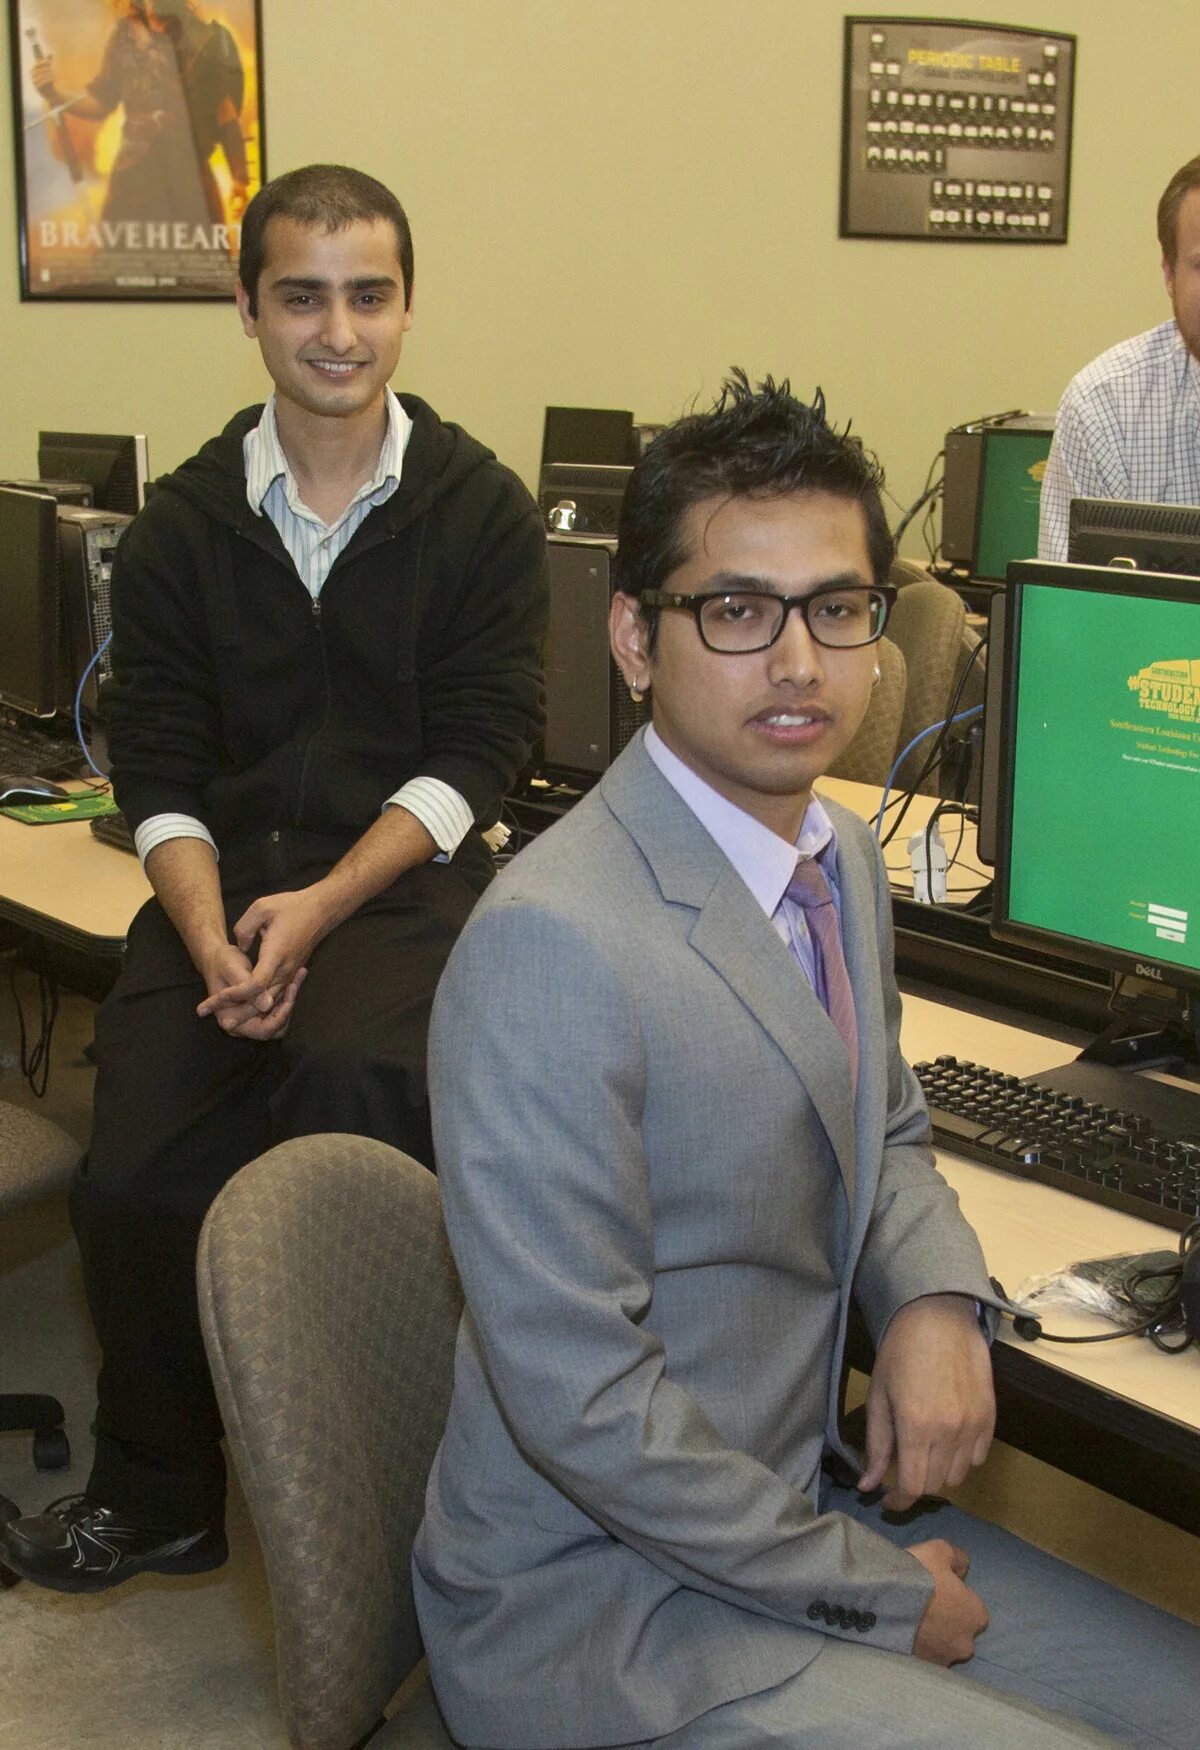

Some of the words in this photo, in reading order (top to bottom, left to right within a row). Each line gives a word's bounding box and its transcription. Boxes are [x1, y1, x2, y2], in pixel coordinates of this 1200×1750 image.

[908, 49, 974, 69] PERIODIC
[979, 56, 1020, 73] TABLE
[1140, 698, 1195, 717] TECHNOLOGY
[1108, 719, 1155, 735] Southeastern
[1156, 728, 1191, 740] Louisiana
[1135, 963, 1163, 981] DELL
